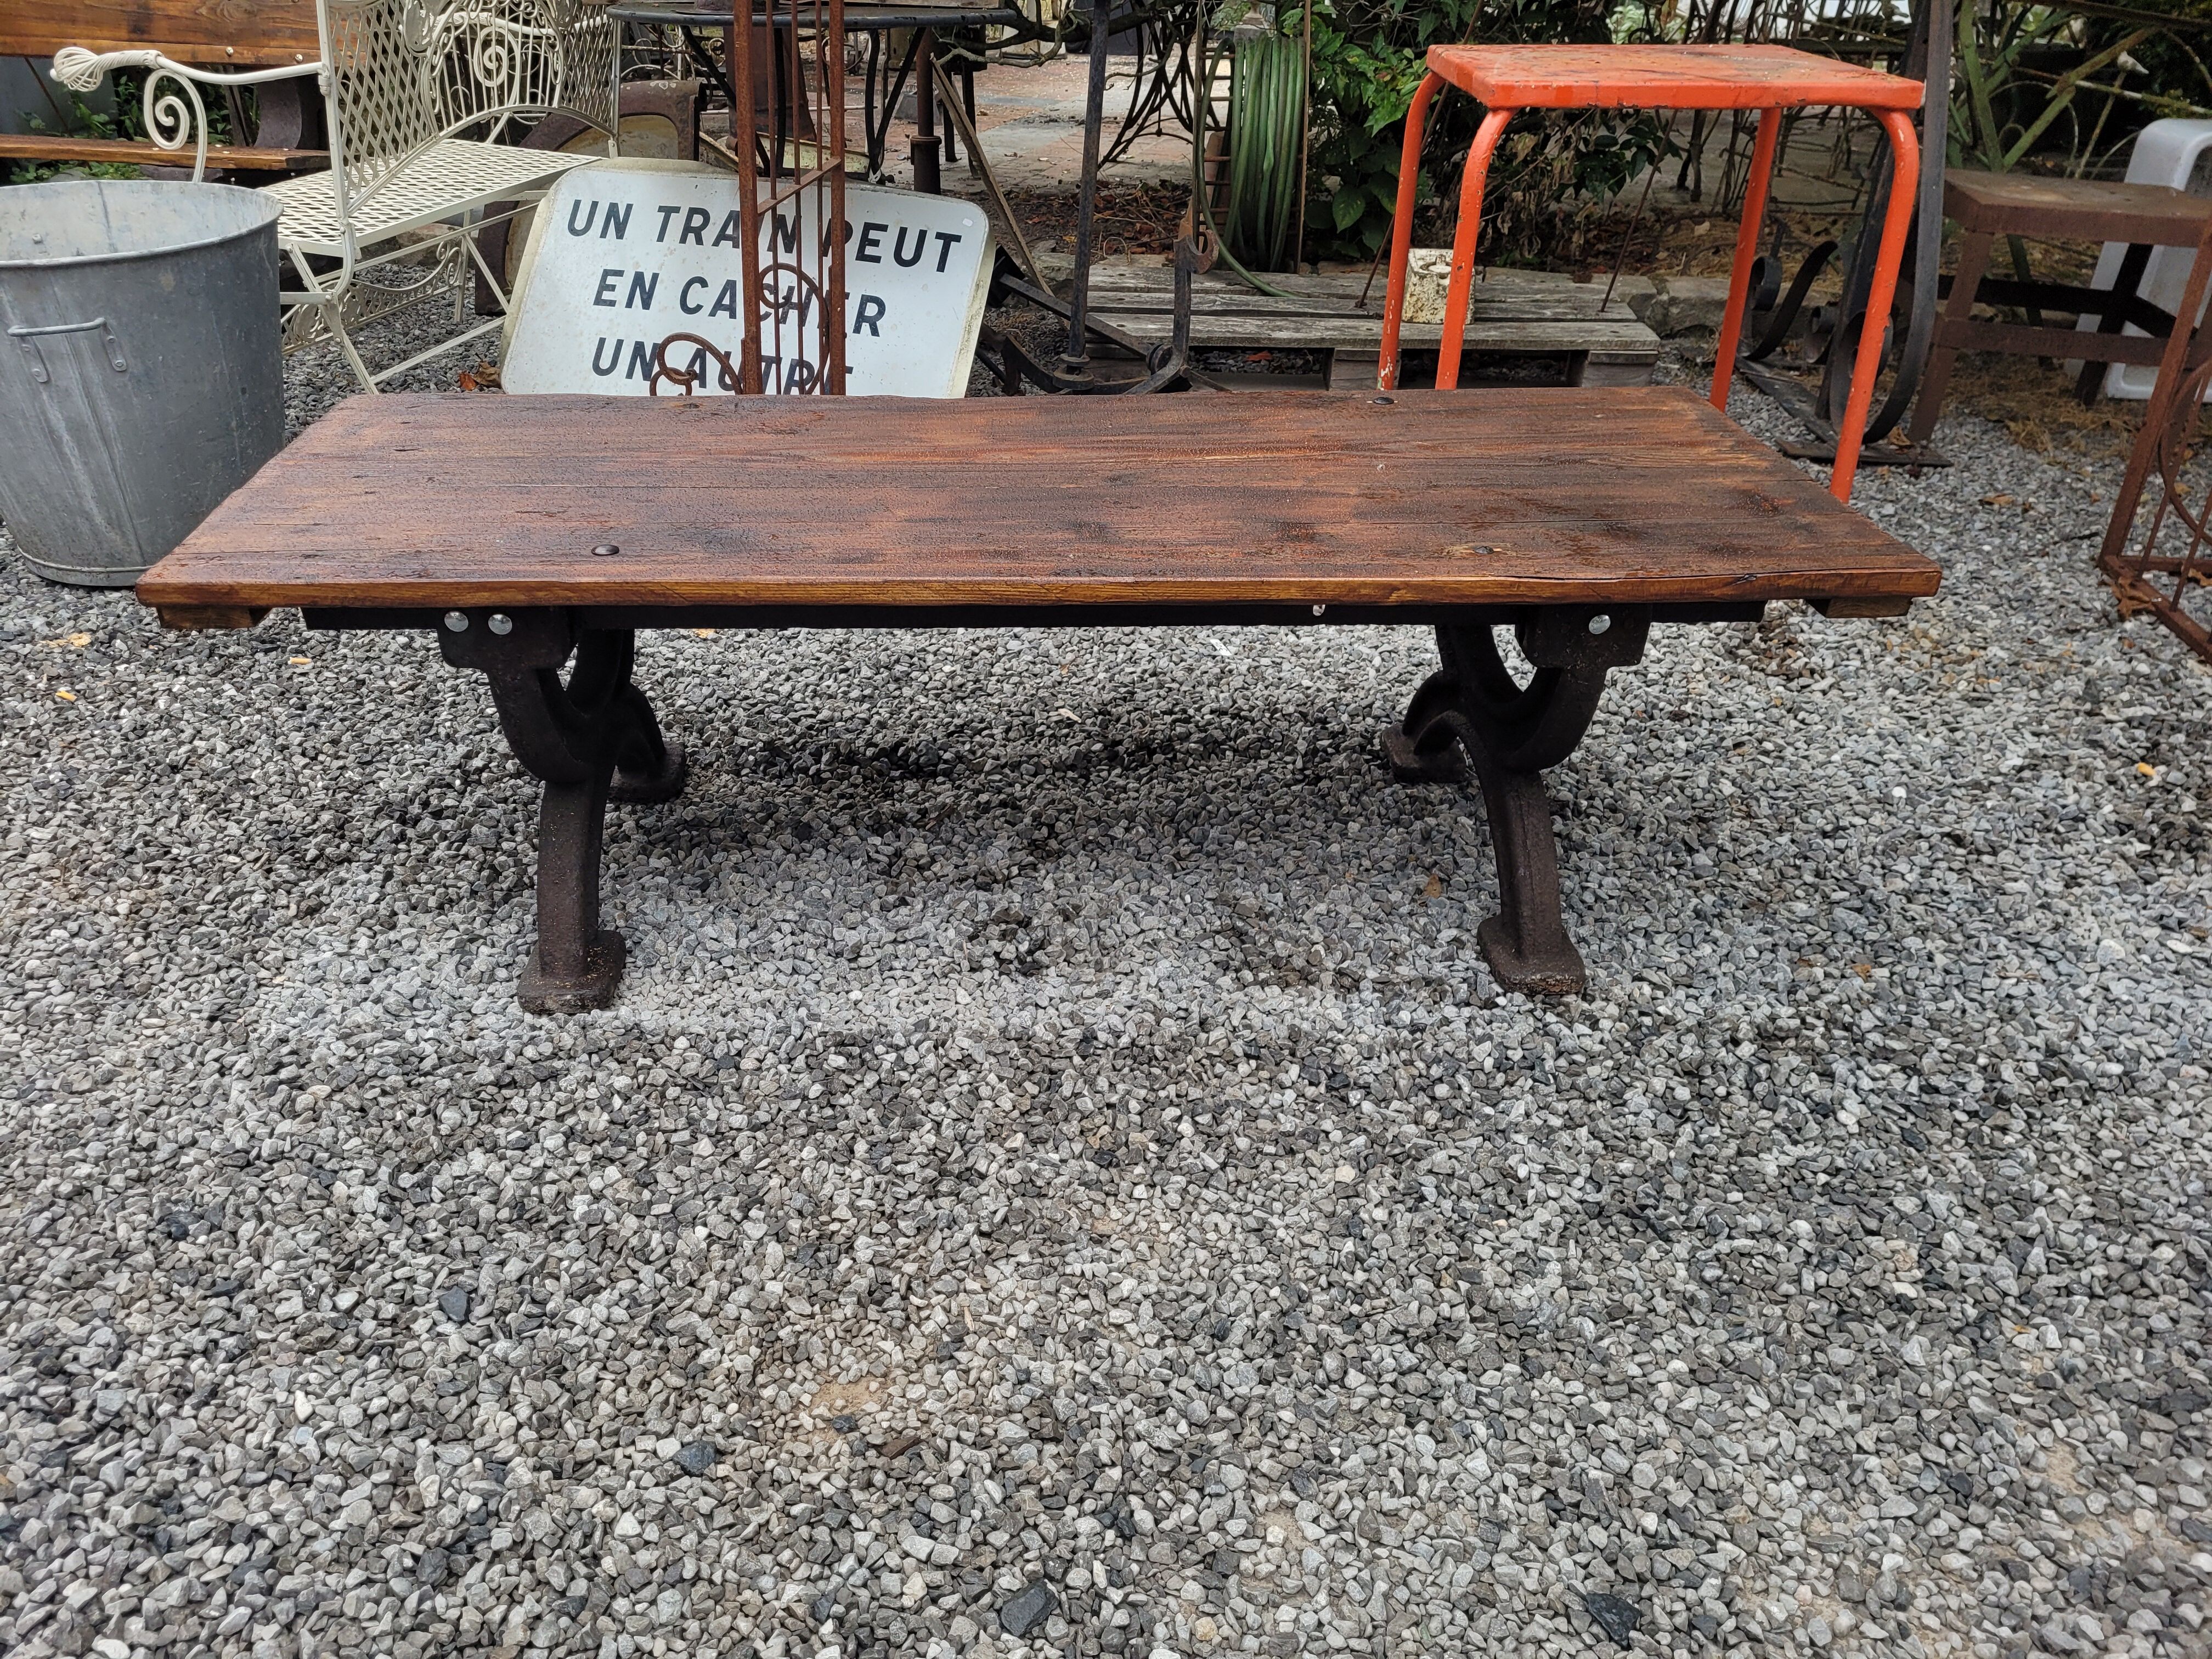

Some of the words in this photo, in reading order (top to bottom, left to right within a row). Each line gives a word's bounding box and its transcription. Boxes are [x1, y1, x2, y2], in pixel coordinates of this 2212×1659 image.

[568, 199, 633, 240] UN
[822, 218, 962, 273] PEUT
[593, 269, 659, 311] EN
[679, 276, 886, 337] CAHR
[592, 337, 660, 382] UN
[685, 347, 854, 395] ATR
